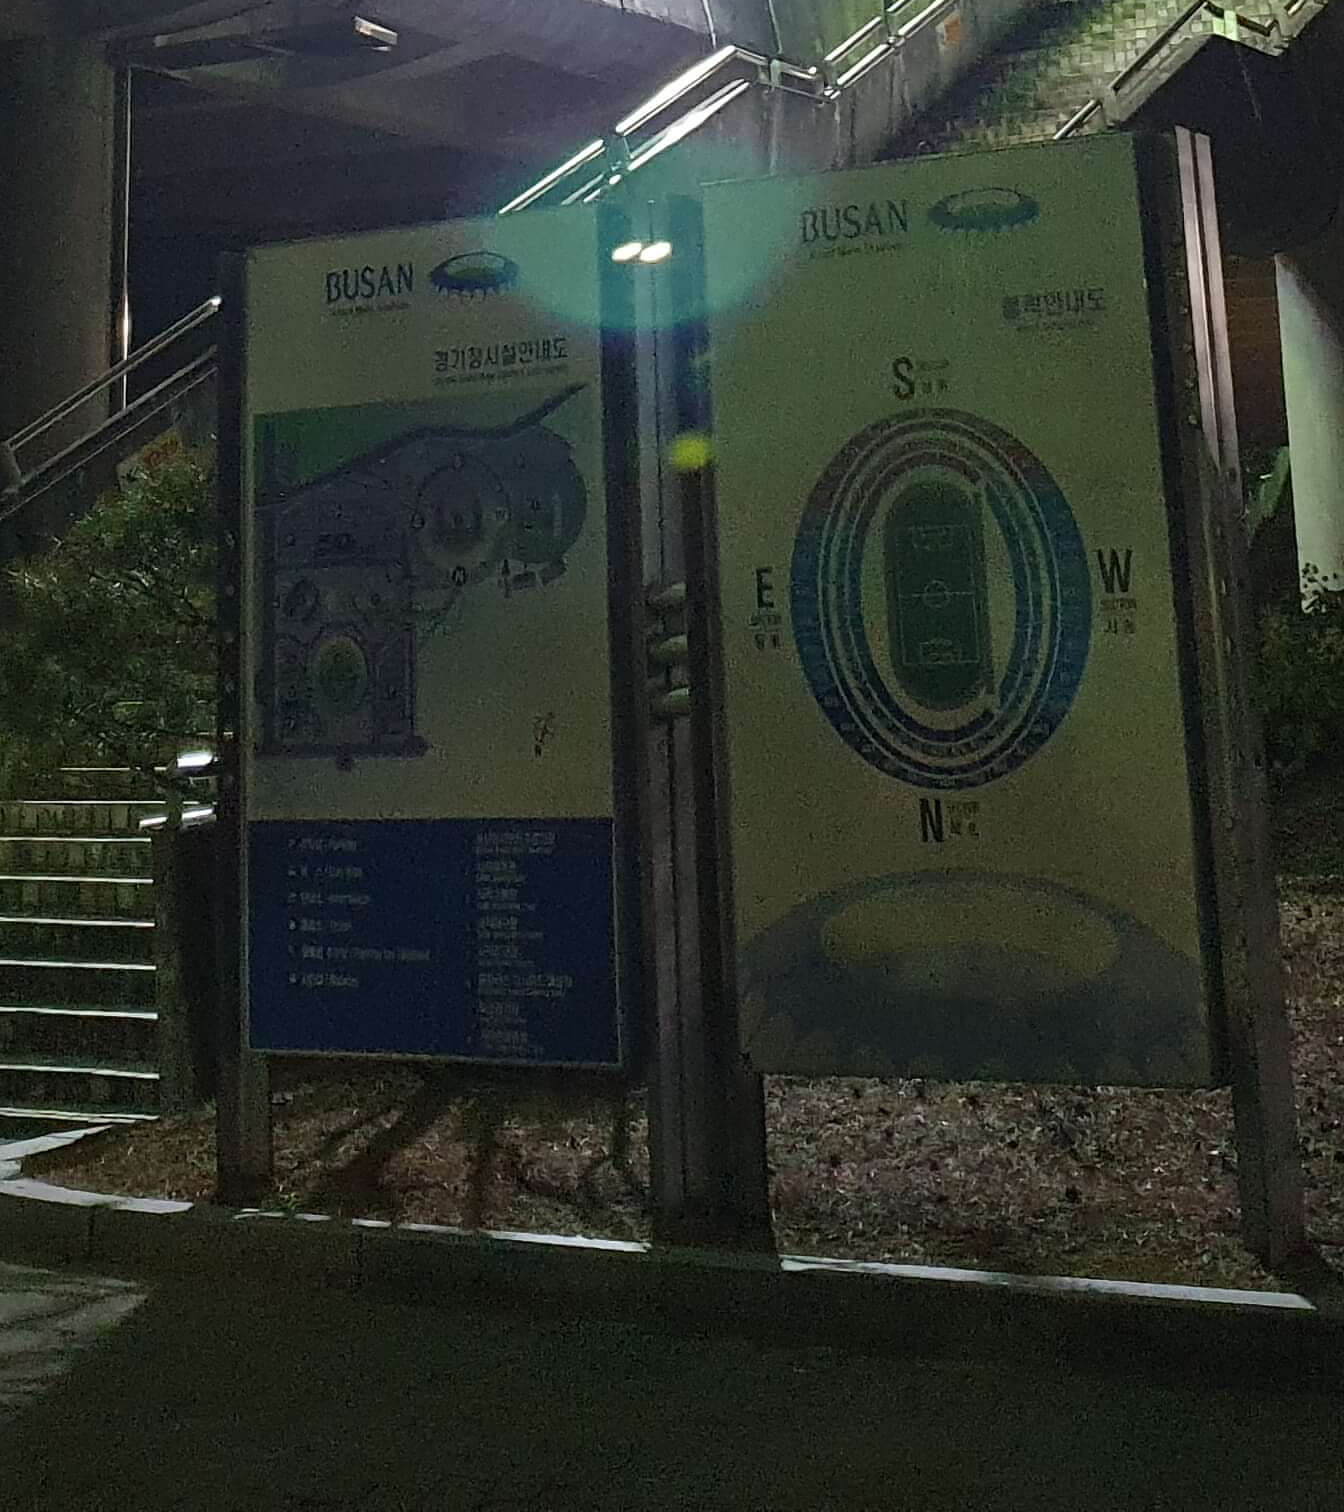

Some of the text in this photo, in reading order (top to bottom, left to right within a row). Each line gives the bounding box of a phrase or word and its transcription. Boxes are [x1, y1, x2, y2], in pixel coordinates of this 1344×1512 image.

[802, 199, 909, 243] BUSAN
[326, 262, 414, 304] BUSAN
[434, 337, 568, 373] 경기장시설안내도
[892, 355, 916, 400] S
[755, 566, 774, 609] E
[1096, 548, 1134, 594] W
[919, 797, 945, 843] N
